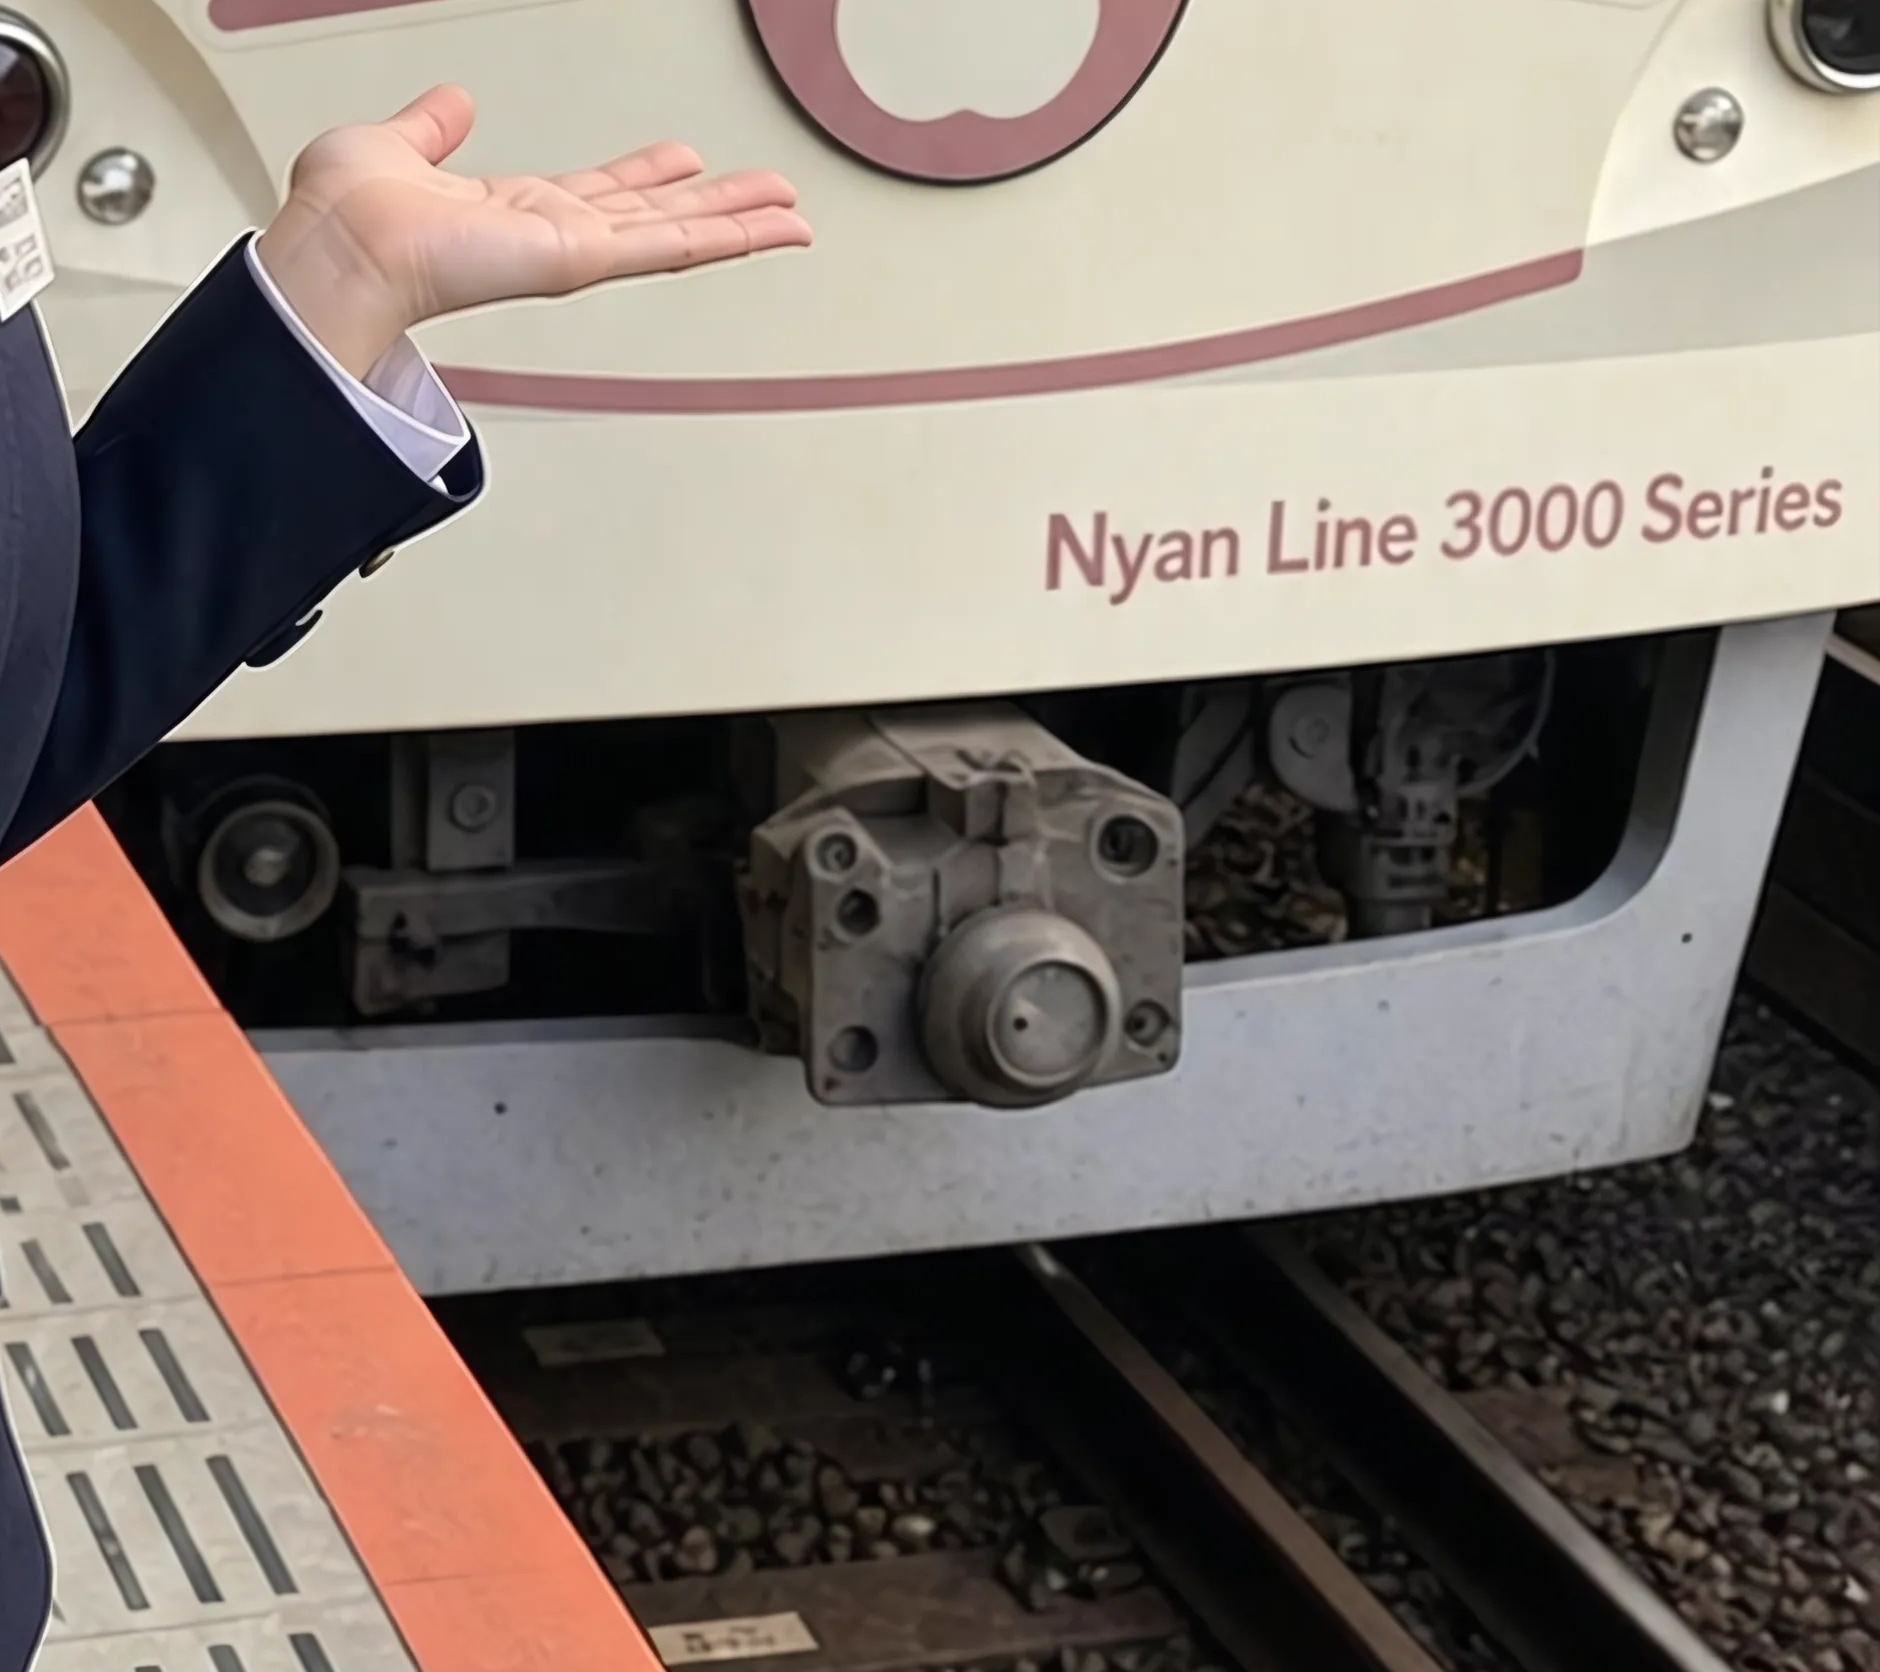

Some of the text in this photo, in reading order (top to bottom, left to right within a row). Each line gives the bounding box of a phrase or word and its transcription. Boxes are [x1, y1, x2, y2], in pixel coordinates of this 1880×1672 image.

[1043, 464, 1844, 606] Nyan Line 3000 Series
